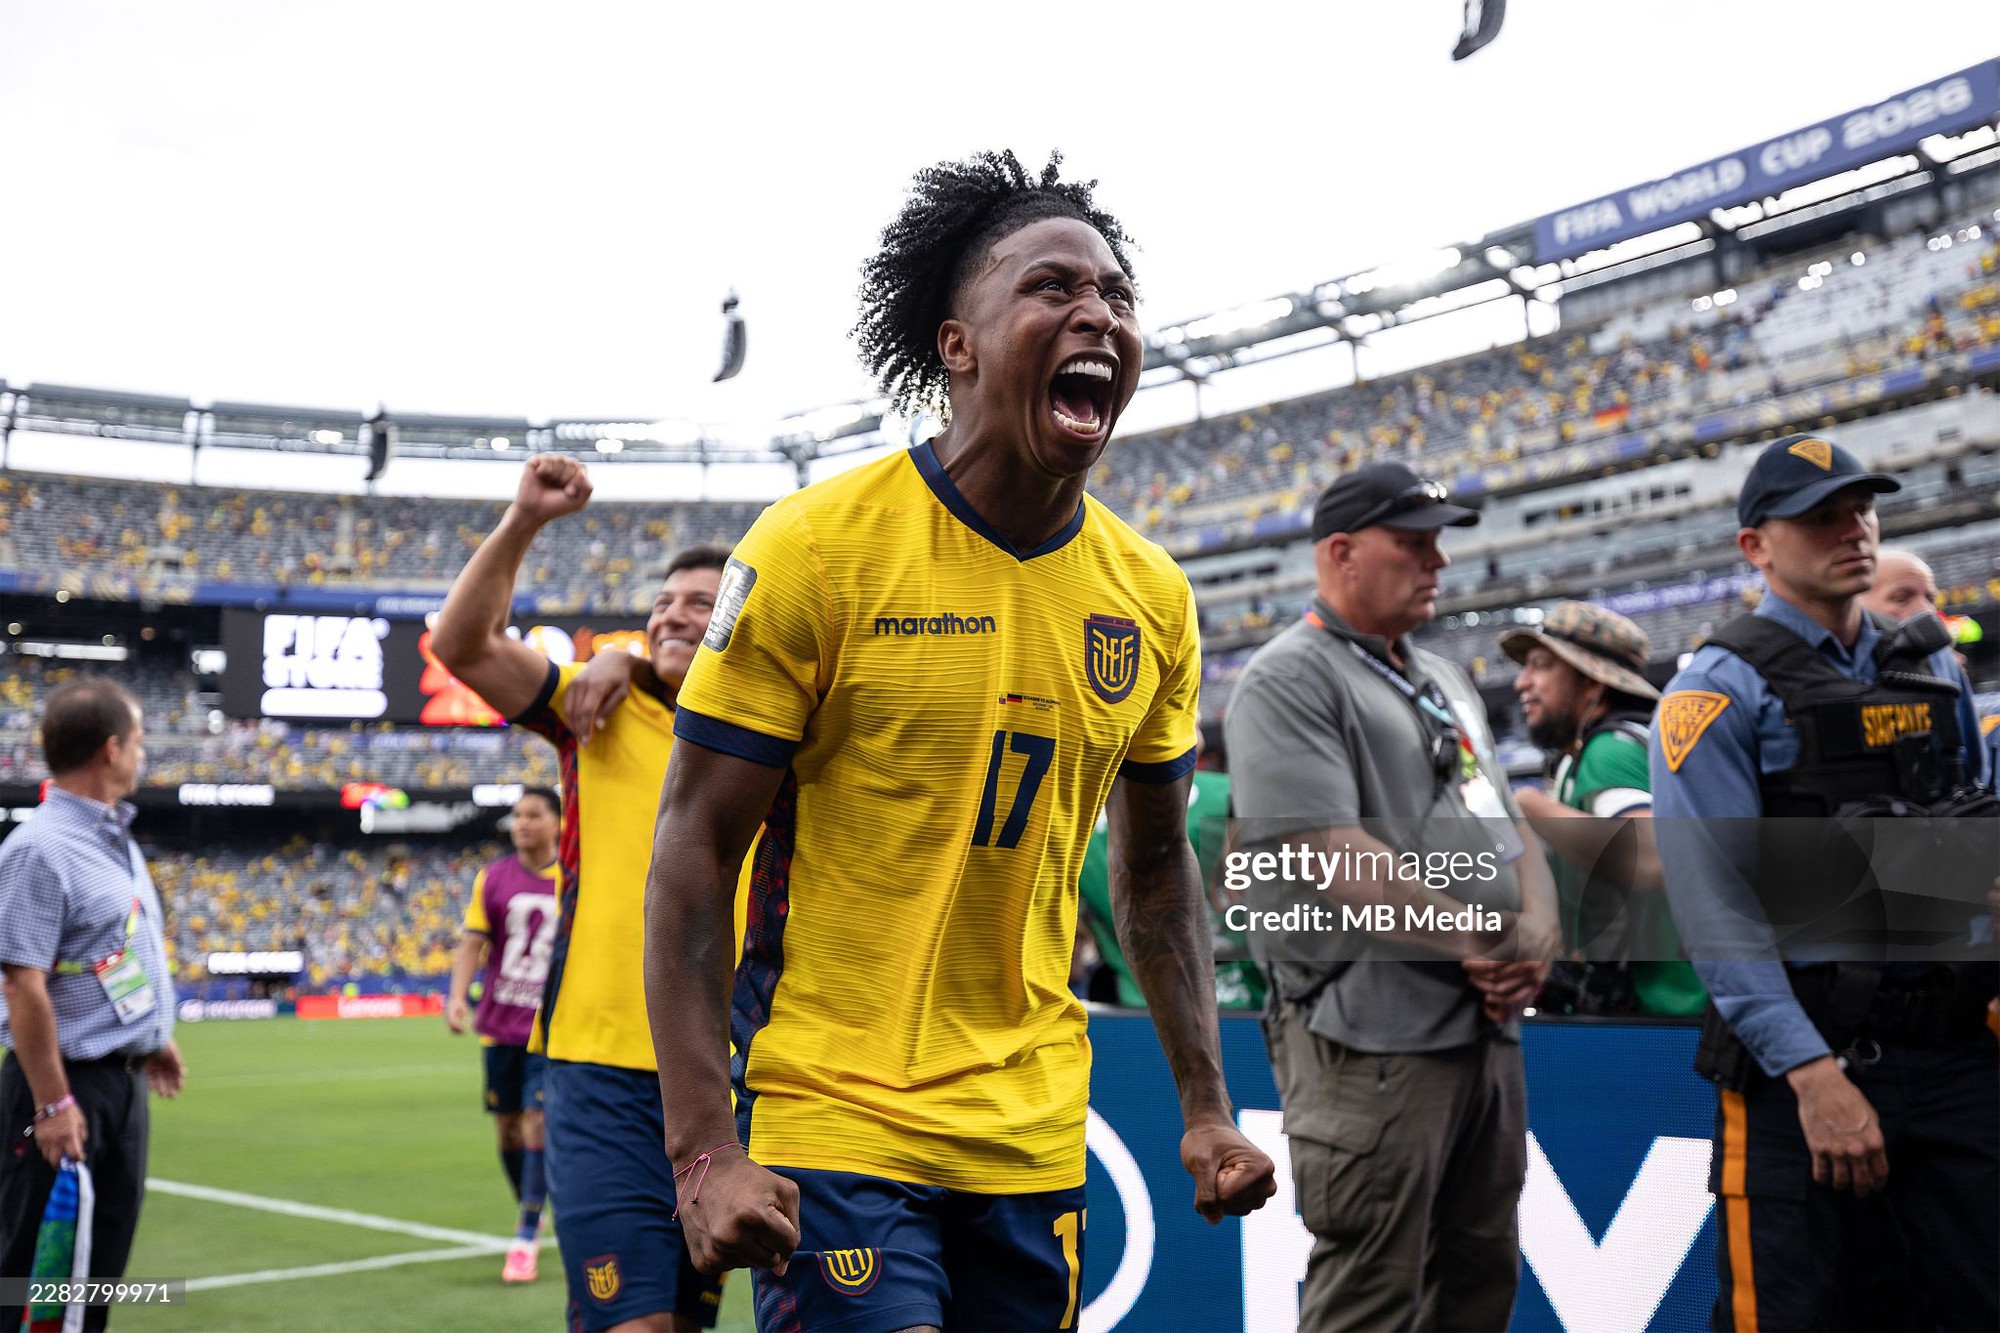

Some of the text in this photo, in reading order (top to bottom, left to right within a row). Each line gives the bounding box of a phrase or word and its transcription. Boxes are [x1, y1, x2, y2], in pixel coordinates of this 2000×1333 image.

[1552, 76, 1973, 246] FIFA WORLD CUP 2026
[264, 614, 383, 662] FIFA
[875, 613, 996, 635] marathon
[971, 730, 1056, 849] 17
[1053, 1207, 1087, 1330] 1
